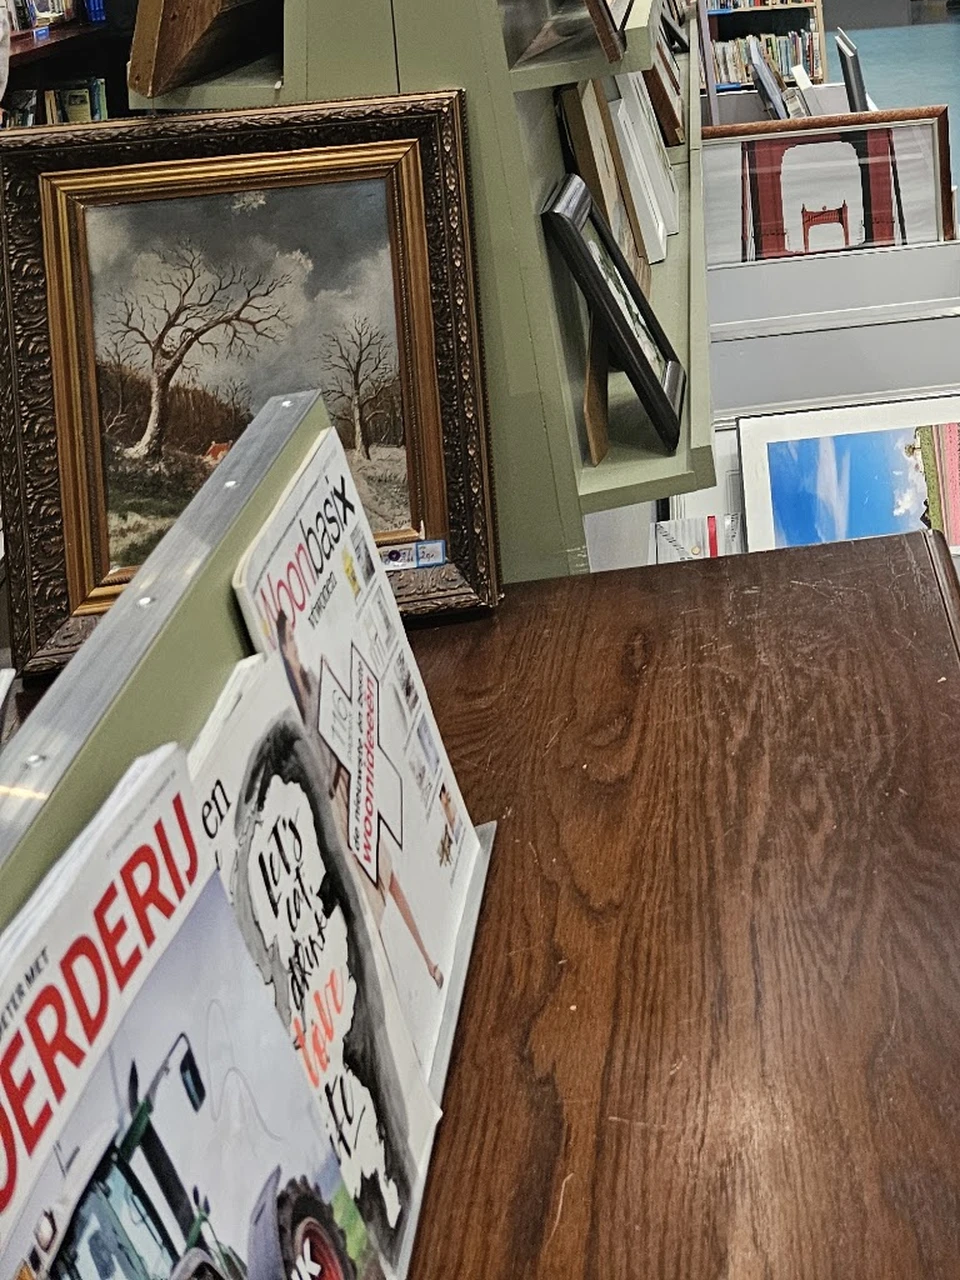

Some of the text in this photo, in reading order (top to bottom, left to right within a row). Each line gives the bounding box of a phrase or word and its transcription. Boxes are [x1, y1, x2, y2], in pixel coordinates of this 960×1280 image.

[256, 474, 356, 651] Woonbasix
[201, 778, 232, 840] en
[24, 947, 51, 993] MET
